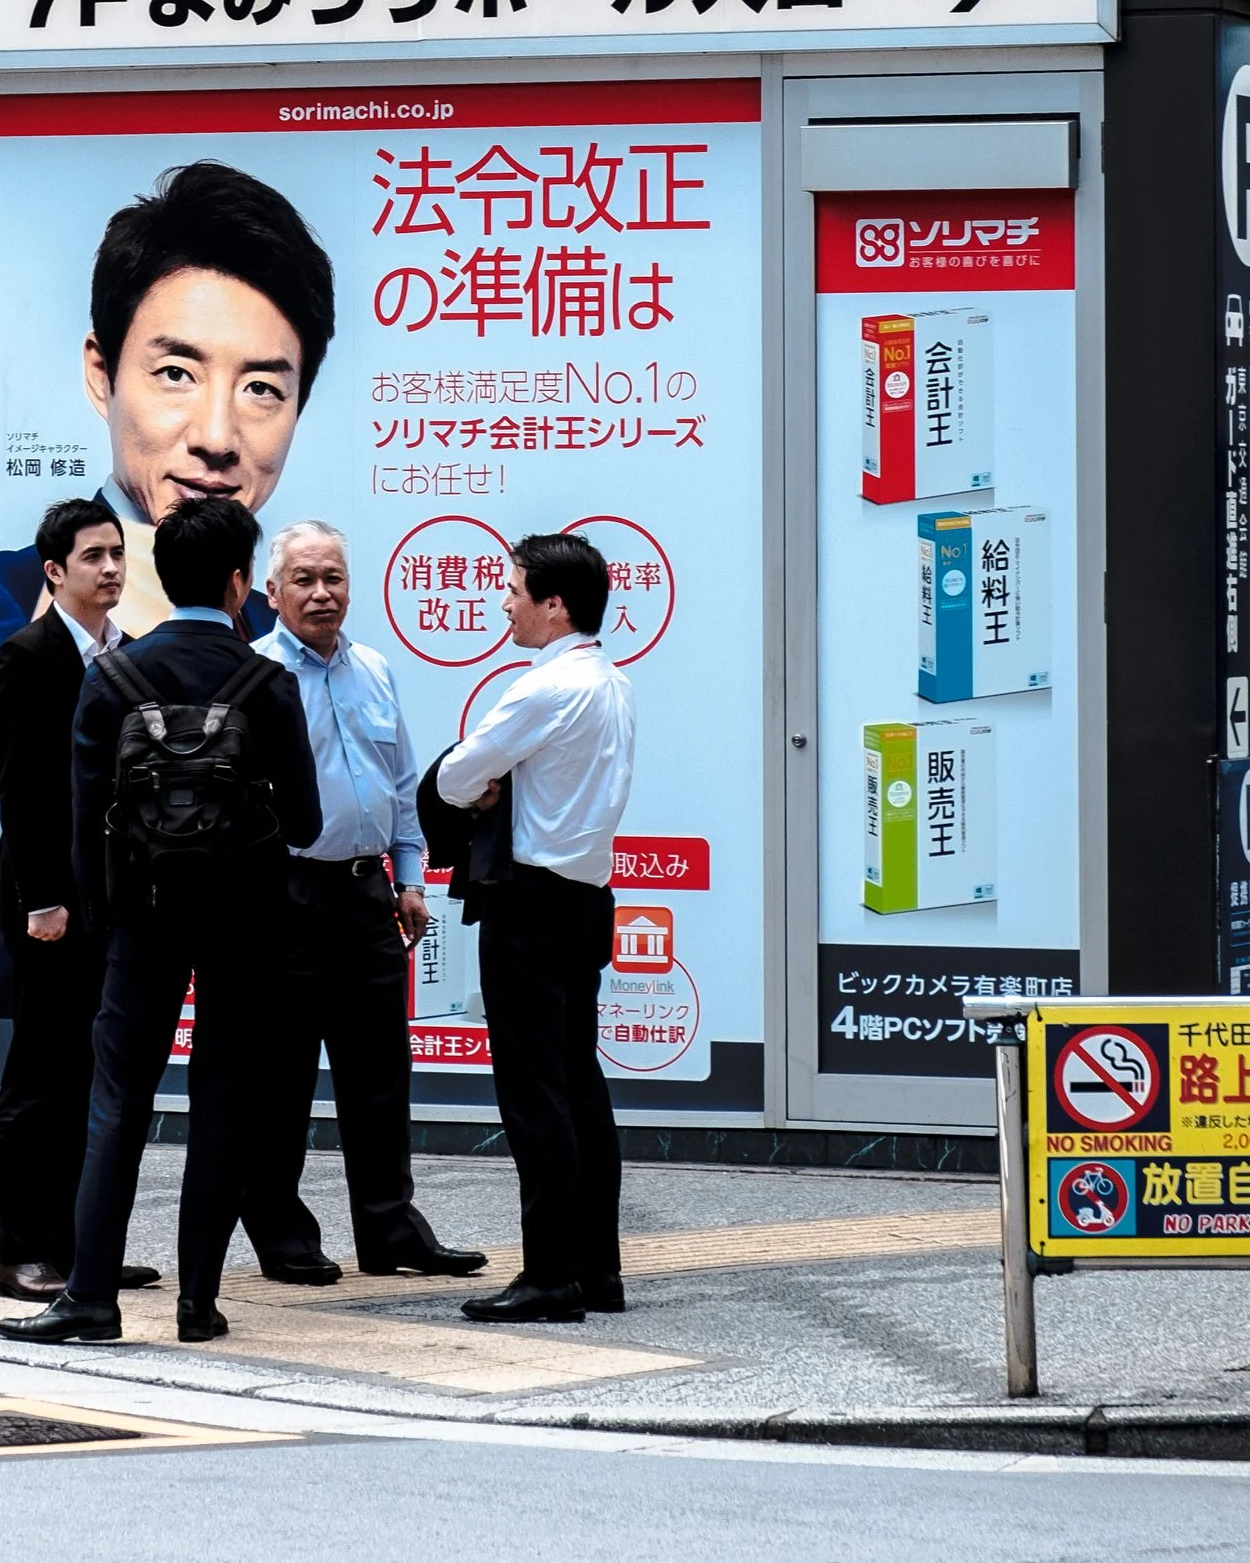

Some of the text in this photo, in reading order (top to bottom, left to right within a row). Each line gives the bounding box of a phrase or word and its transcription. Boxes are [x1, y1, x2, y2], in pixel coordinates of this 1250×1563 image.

[278, 100, 455, 121] sorimachi.co.jp
[371, 141, 711, 237] 法令改正
[909, 216, 1040, 247] ソリマチ
[909, 254, 1041, 269] お客様の喜びを喜びに
[373, 244, 675, 338] の準備は
[371, 360, 698, 406] お客様満足度No.1の
[925, 340, 954, 448] 会計王
[6, 432, 39, 441] ソリマチ
[371, 413, 707, 451] ソリマチ会計王シリーズ
[6, 444, 88, 453] イメージキャラクター
[5, 458, 86, 477] 松岡 修造
[371, 462, 506, 498] にお任せ!
[400, 554, 506, 592] 消費税
[981, 538, 1010, 645] 給料王
[418, 597, 488, 634] 改正
[927, 749, 956, 858] 販売王
[838, 970, 1075, 996] ビックカメラ有楽町店
[1178, 1023, 1250, 1047] 千代田
[1047, 1133, 1173, 1152] NO SMOKING
[1223, 1134, 1250, 1149] 2,0
[1164, 1214, 1192, 1234] NO
